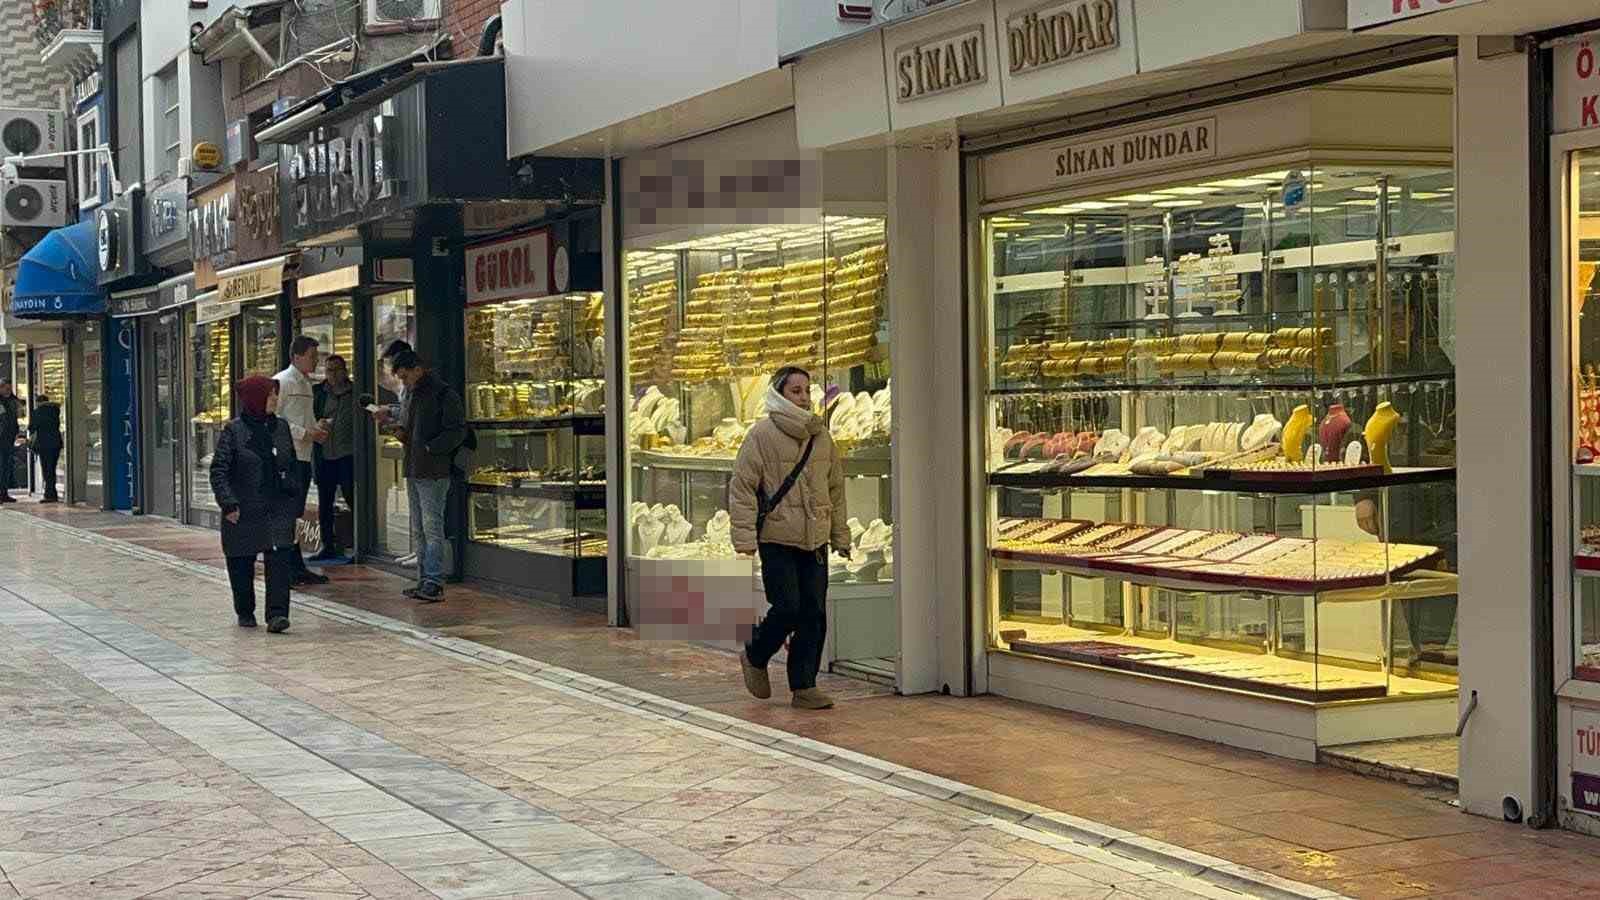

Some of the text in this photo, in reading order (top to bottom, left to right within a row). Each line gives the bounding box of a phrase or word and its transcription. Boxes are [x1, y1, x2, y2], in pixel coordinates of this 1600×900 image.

[898, 0, 1115, 98] SİNAN DÜNDAR
[1055, 126, 1209, 176] SİNAN DÜNDAR
